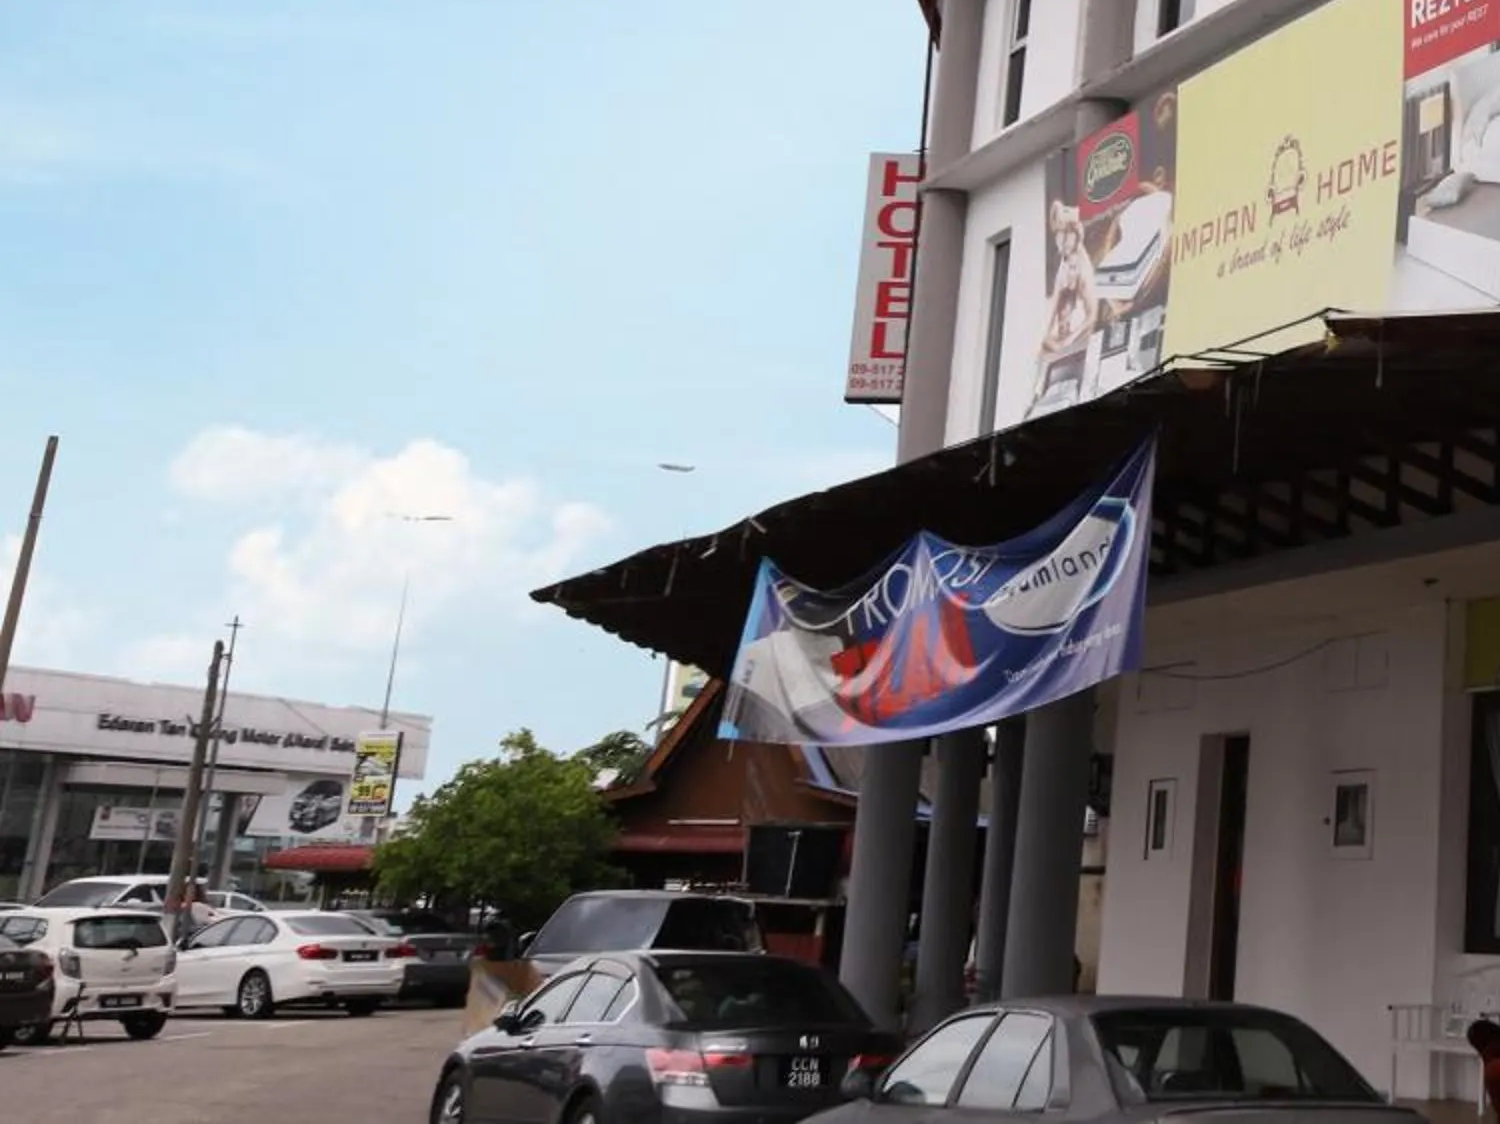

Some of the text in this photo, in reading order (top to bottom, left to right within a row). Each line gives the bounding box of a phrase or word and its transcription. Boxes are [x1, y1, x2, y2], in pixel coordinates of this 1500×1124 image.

[1174, 140, 1398, 263] IMPIAN HOME
[1270, 231, 1285, 264] of
[1316, 204, 1352, 243] style
[870, 161, 926, 359] HOTEL
[159, 719, 187, 736] Tan
